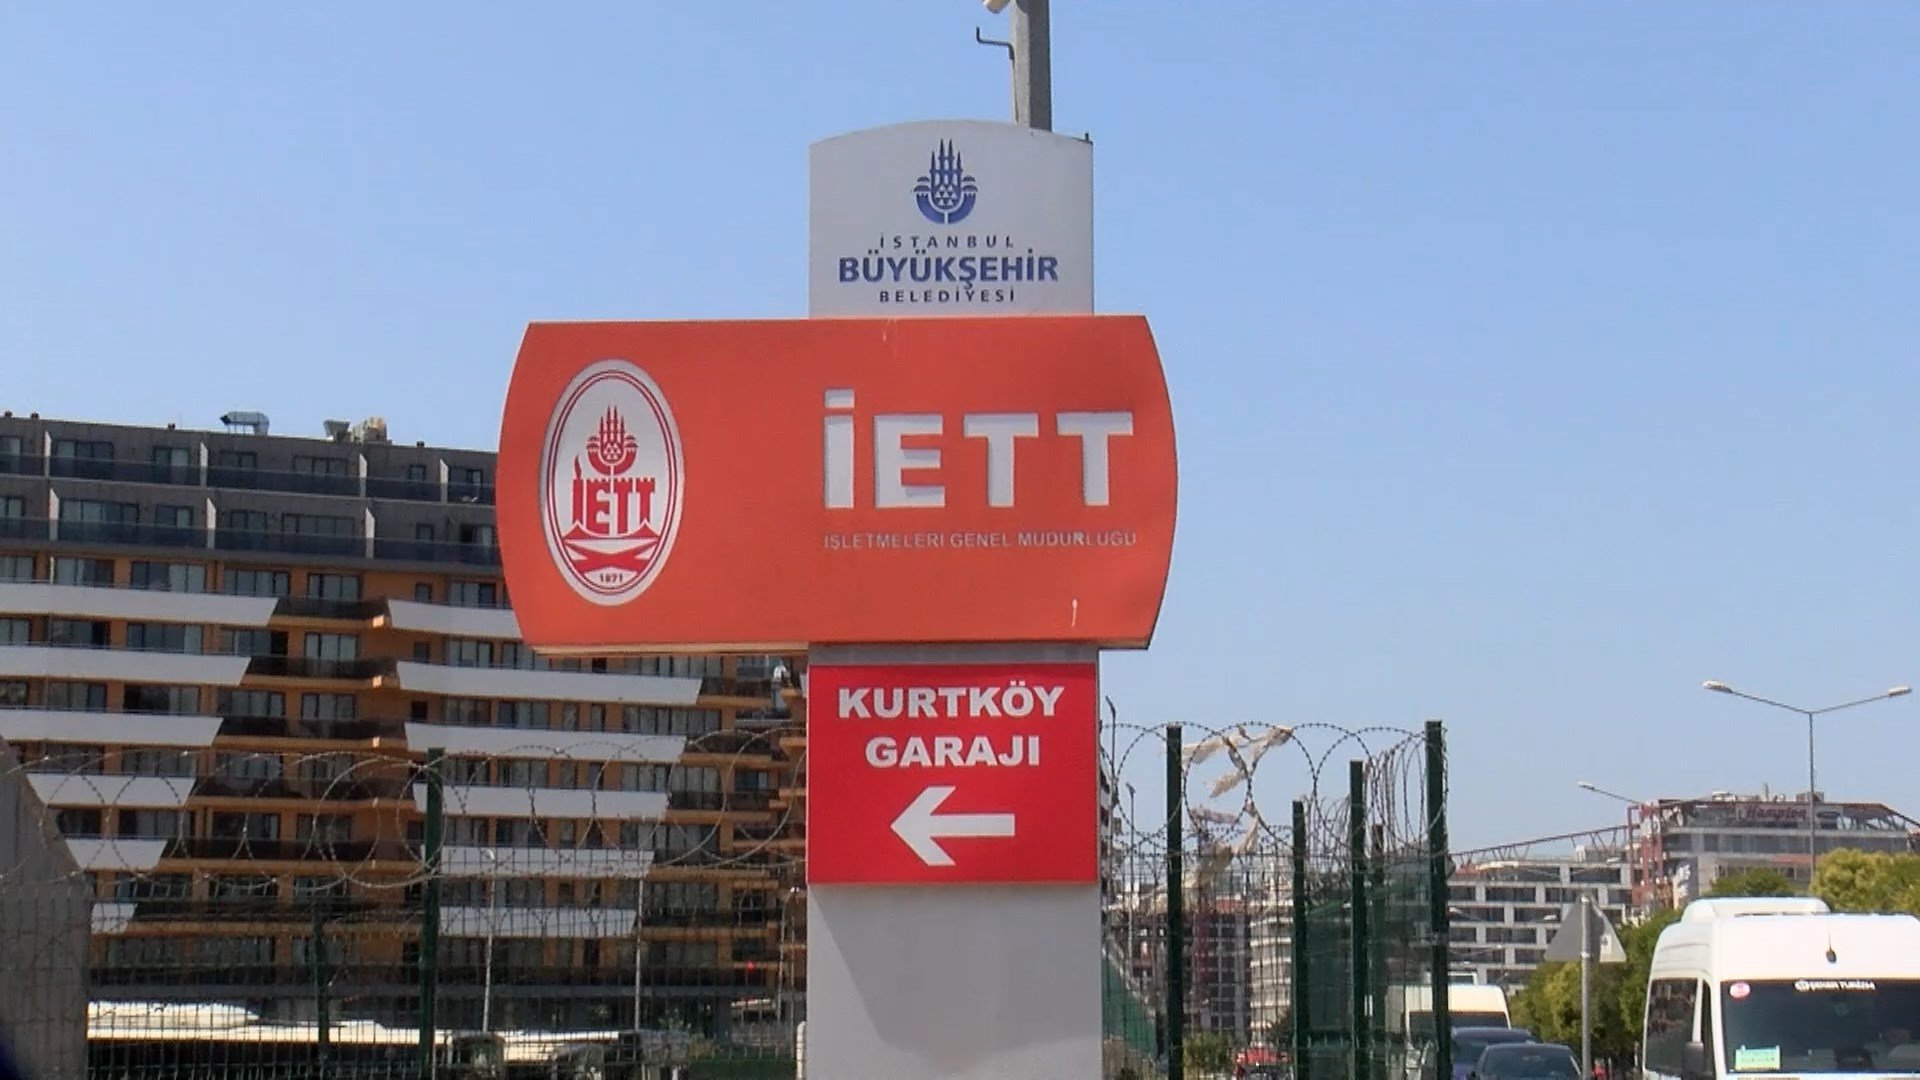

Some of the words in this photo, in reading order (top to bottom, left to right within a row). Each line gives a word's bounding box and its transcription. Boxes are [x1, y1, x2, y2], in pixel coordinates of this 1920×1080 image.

[879, 233, 1014, 248] İSTANBUL
[839, 249, 1059, 289] BÜYÜKŞEHİR
[880, 286, 1015, 303] BELEDİYESİ
[824, 388, 1135, 509] İETT
[950, 532, 1009, 547] GENEL
[838, 680, 1065, 719] KURTKÖY
[864, 735, 1041, 768] GARAJI
